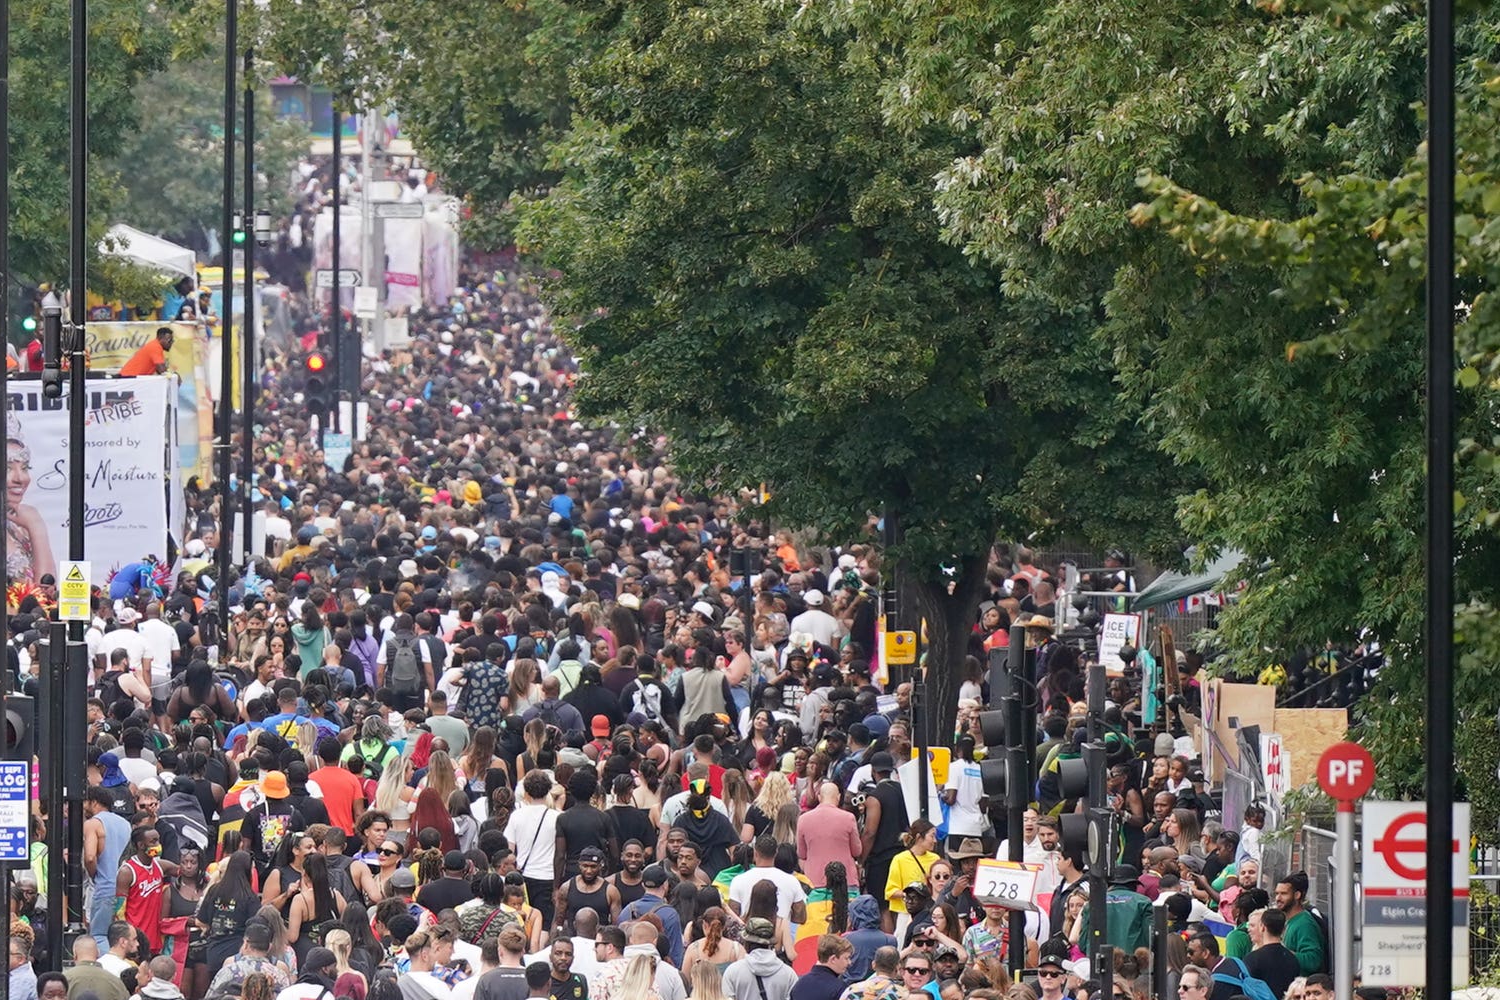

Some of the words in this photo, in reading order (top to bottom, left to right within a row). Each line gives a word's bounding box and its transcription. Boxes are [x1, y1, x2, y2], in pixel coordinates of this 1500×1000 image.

[6, 391, 134, 411] RIDIM
[89, 400, 142, 424] TRIBE
[61, 437, 123, 448] Snsored
[126, 437, 141, 449] by
[36, 459, 90, 490] Sa
[91, 459, 157, 490] Moisture
[1106, 621, 1125, 632] ICE
[4, 766, 22, 774] SEPT
[1328, 759, 1364, 786] PF
[987, 880, 1019, 900] 228
[1396, 888, 1413, 896] BUS
[1381, 906, 1406, 919] Elgin
[1407, 906, 1427, 917] Cre
[1378, 941, 1426, 952] Shepherd'
[1369, 964, 1392, 976] 228
